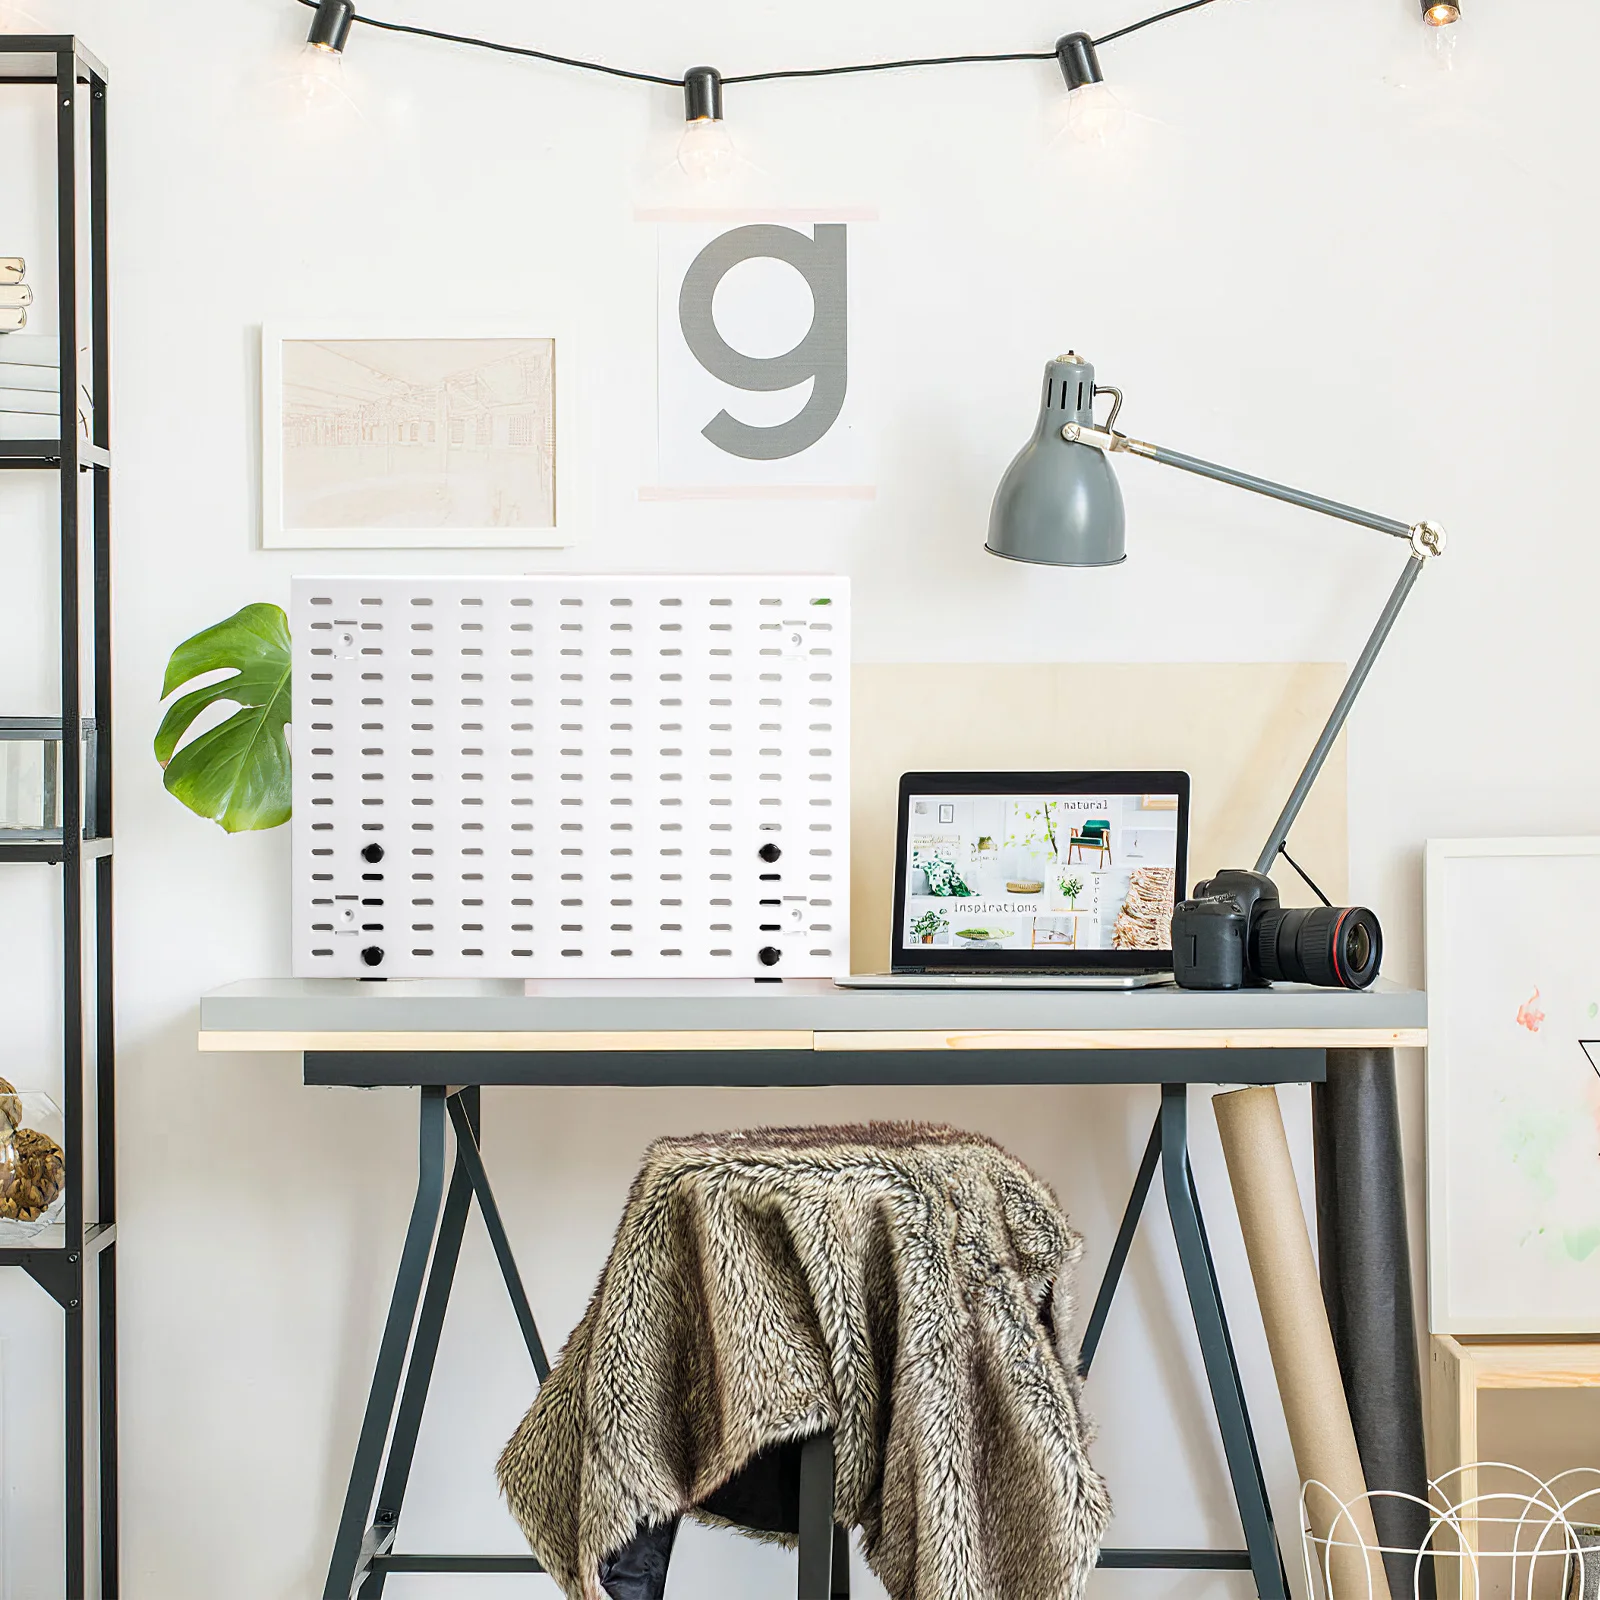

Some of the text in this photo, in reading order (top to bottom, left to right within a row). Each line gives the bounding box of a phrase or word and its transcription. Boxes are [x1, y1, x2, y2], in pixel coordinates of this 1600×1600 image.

[679, 223, 847, 461] g
[1064, 800, 1107, 809] natural
[954, 902, 1037, 913] inspirations
